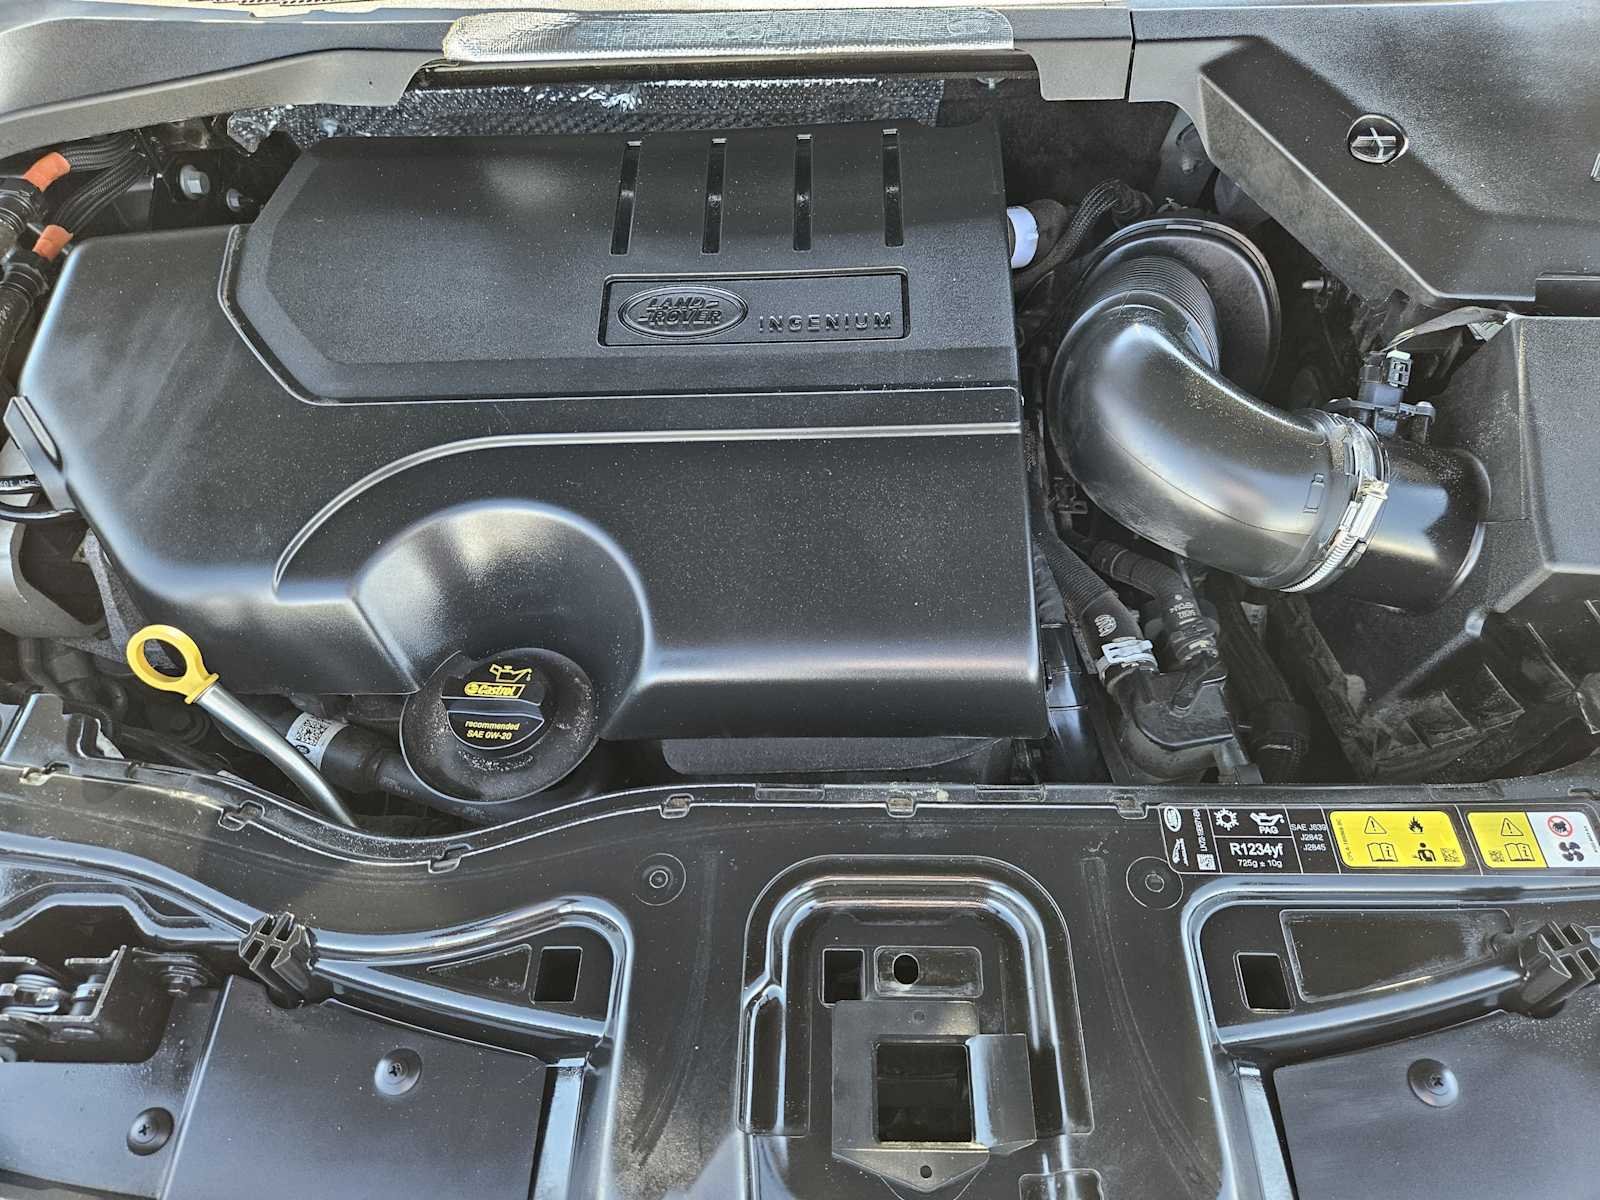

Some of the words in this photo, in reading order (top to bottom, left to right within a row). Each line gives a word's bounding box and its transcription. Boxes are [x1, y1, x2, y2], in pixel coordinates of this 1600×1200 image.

[646, 296, 706, 311] LAND
[650, 310, 722, 325] ROVER
[759, 311, 892, 332] INGENIUM
[478, 684, 516, 696] Castrol
[465, 721, 520, 730] recommended
[467, 730, 485, 738] SAE
[485, 731, 513, 740] 0W-20
[1258, 825, 1279, 834] PAG
[1290, 823, 1308, 831] SAE
[1300, 833, 1324, 841] J2842
[1229, 842, 1283, 859] R1234yf
[1303, 843, 1327, 851] J2845
[1237, 859, 1259, 868] 725g
[1267, 859, 1283, 869] 10g
